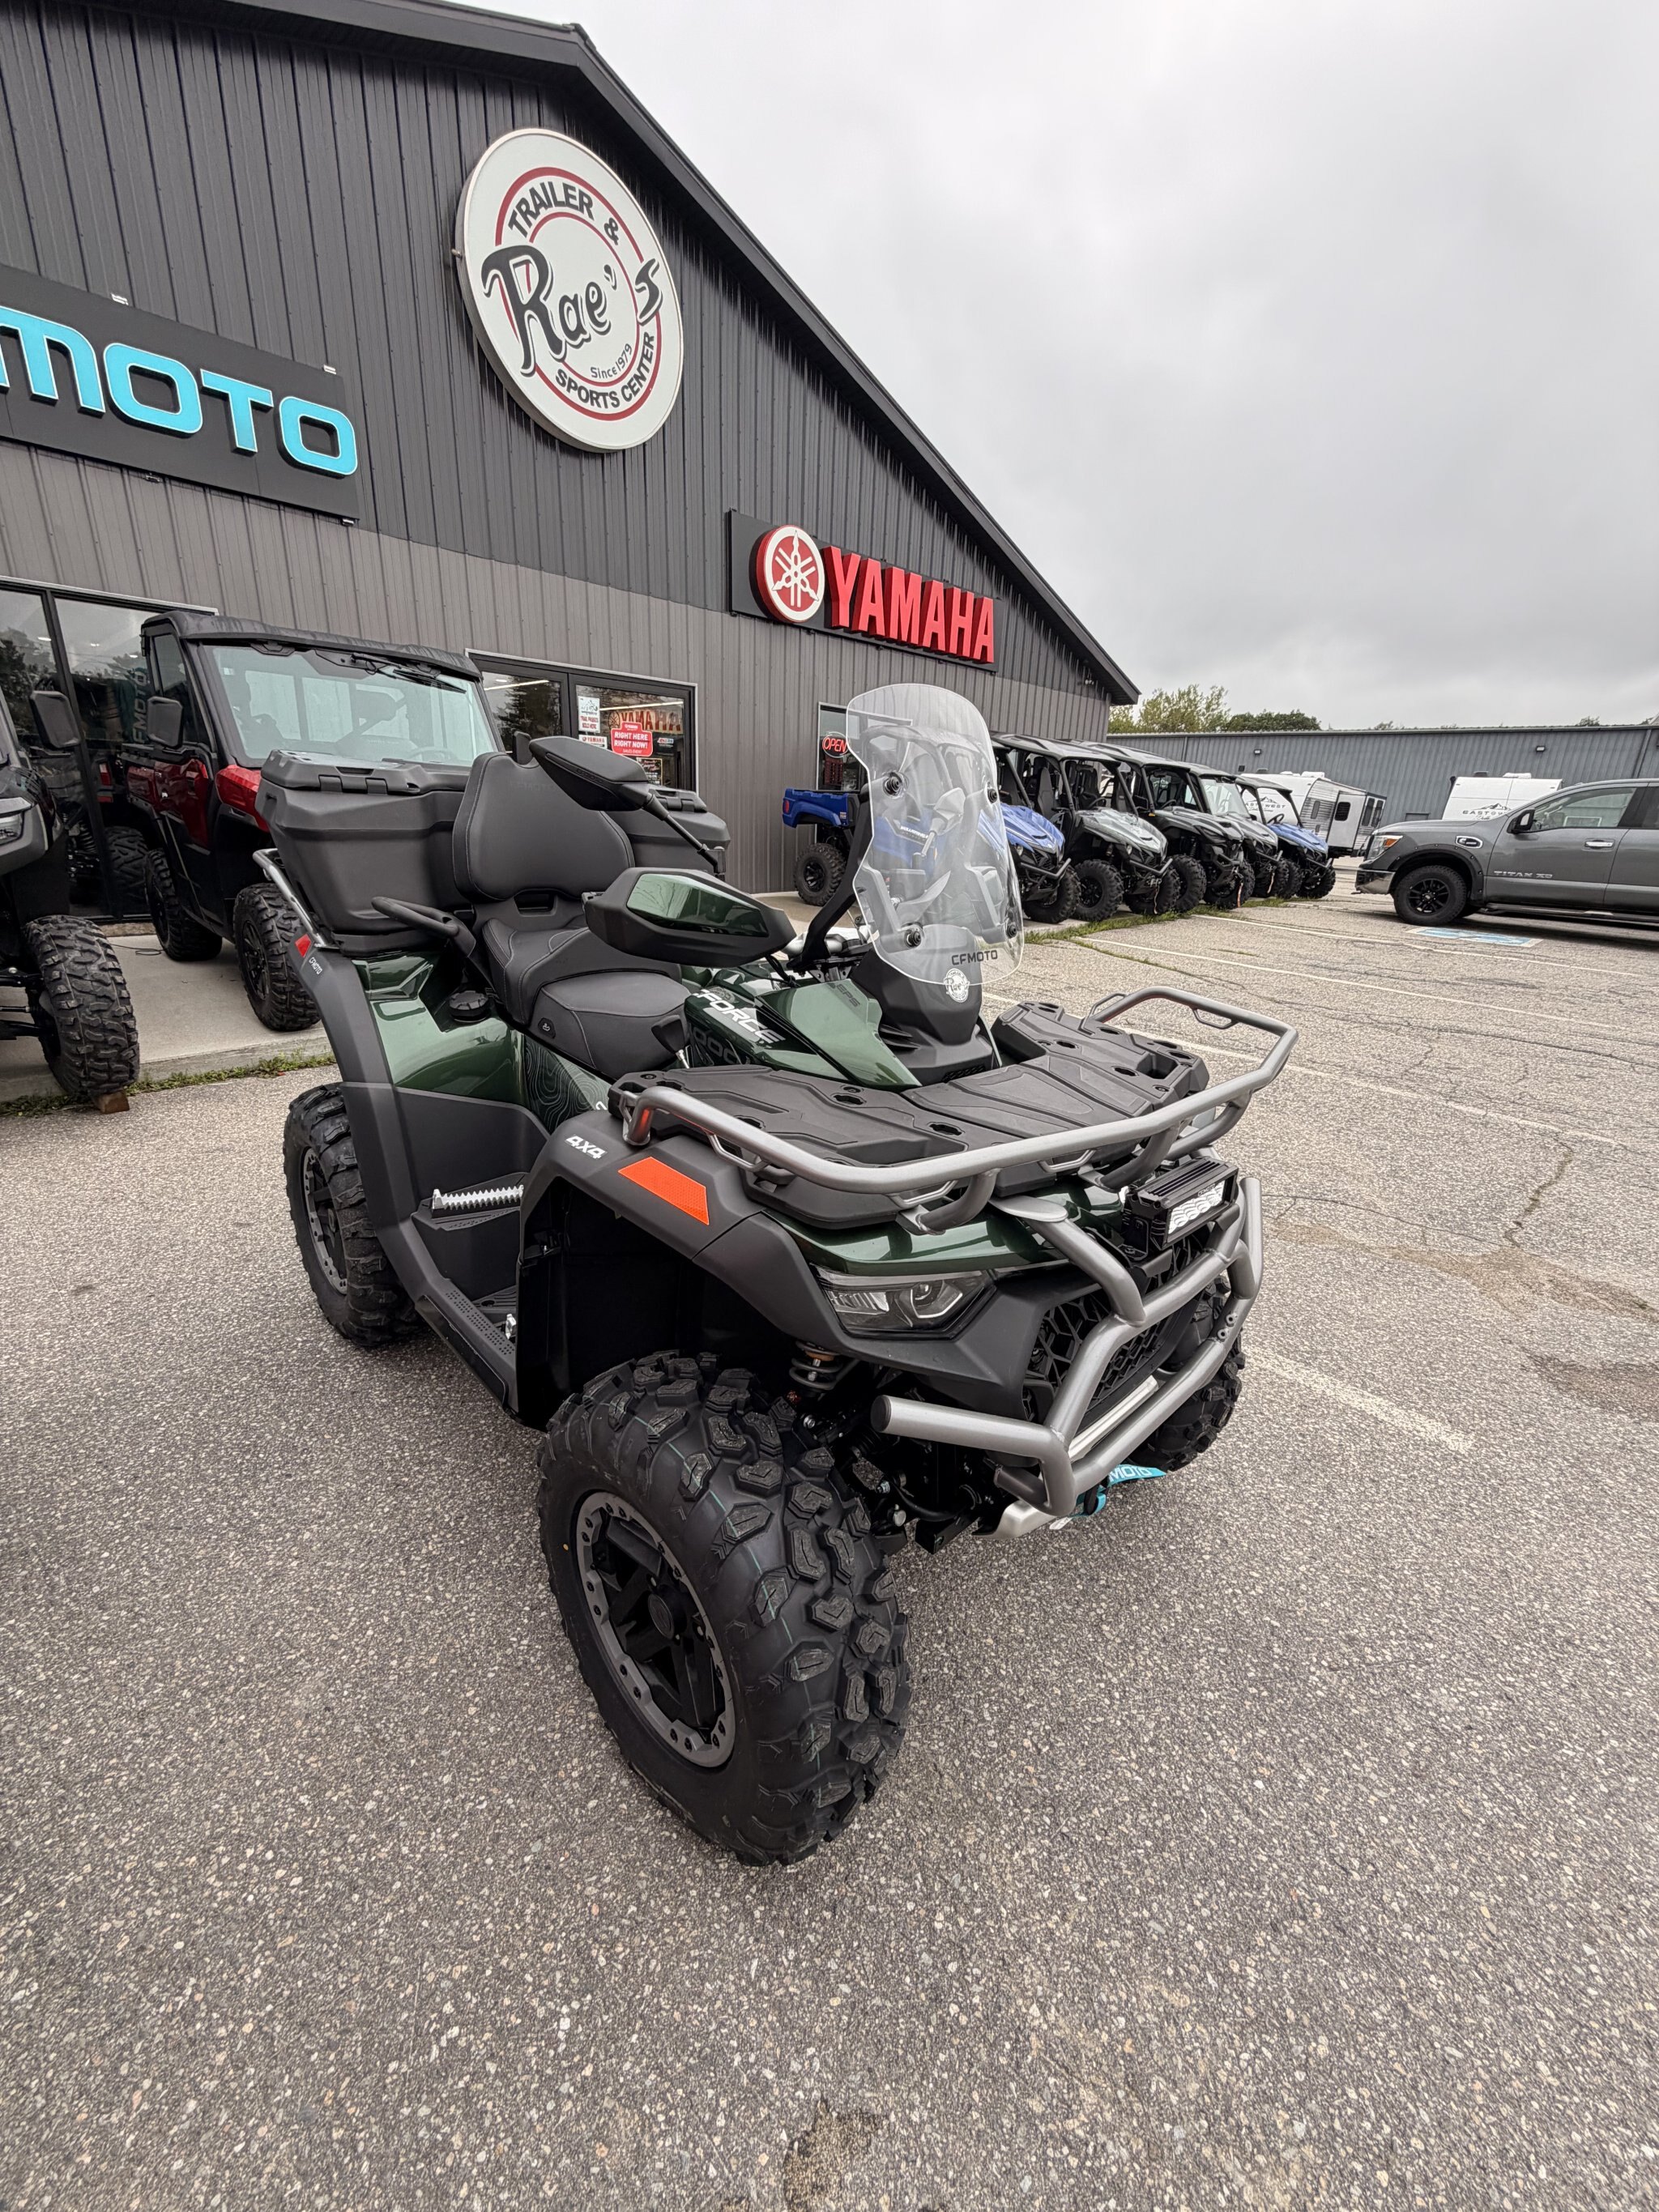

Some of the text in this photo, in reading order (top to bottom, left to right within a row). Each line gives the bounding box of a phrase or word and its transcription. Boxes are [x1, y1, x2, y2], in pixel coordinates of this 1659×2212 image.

[508, 181, 620, 245] TRAILER &
[480, 245, 663, 378] Rae's
[555, 331, 655, 409] SPORTS CENTER
[591, 343, 633, 380] Since 1979
[0, 305, 359, 475] MOTO
[824, 545, 995, 663] YAMAHA
[632, 741, 648, 749] NOW!
[823, 737, 847, 752] OPEN
[951, 949, 998, 965] CFMOTO
[694, 988, 787, 1044] FORCE
[835, 983, 861, 1008] EPS
